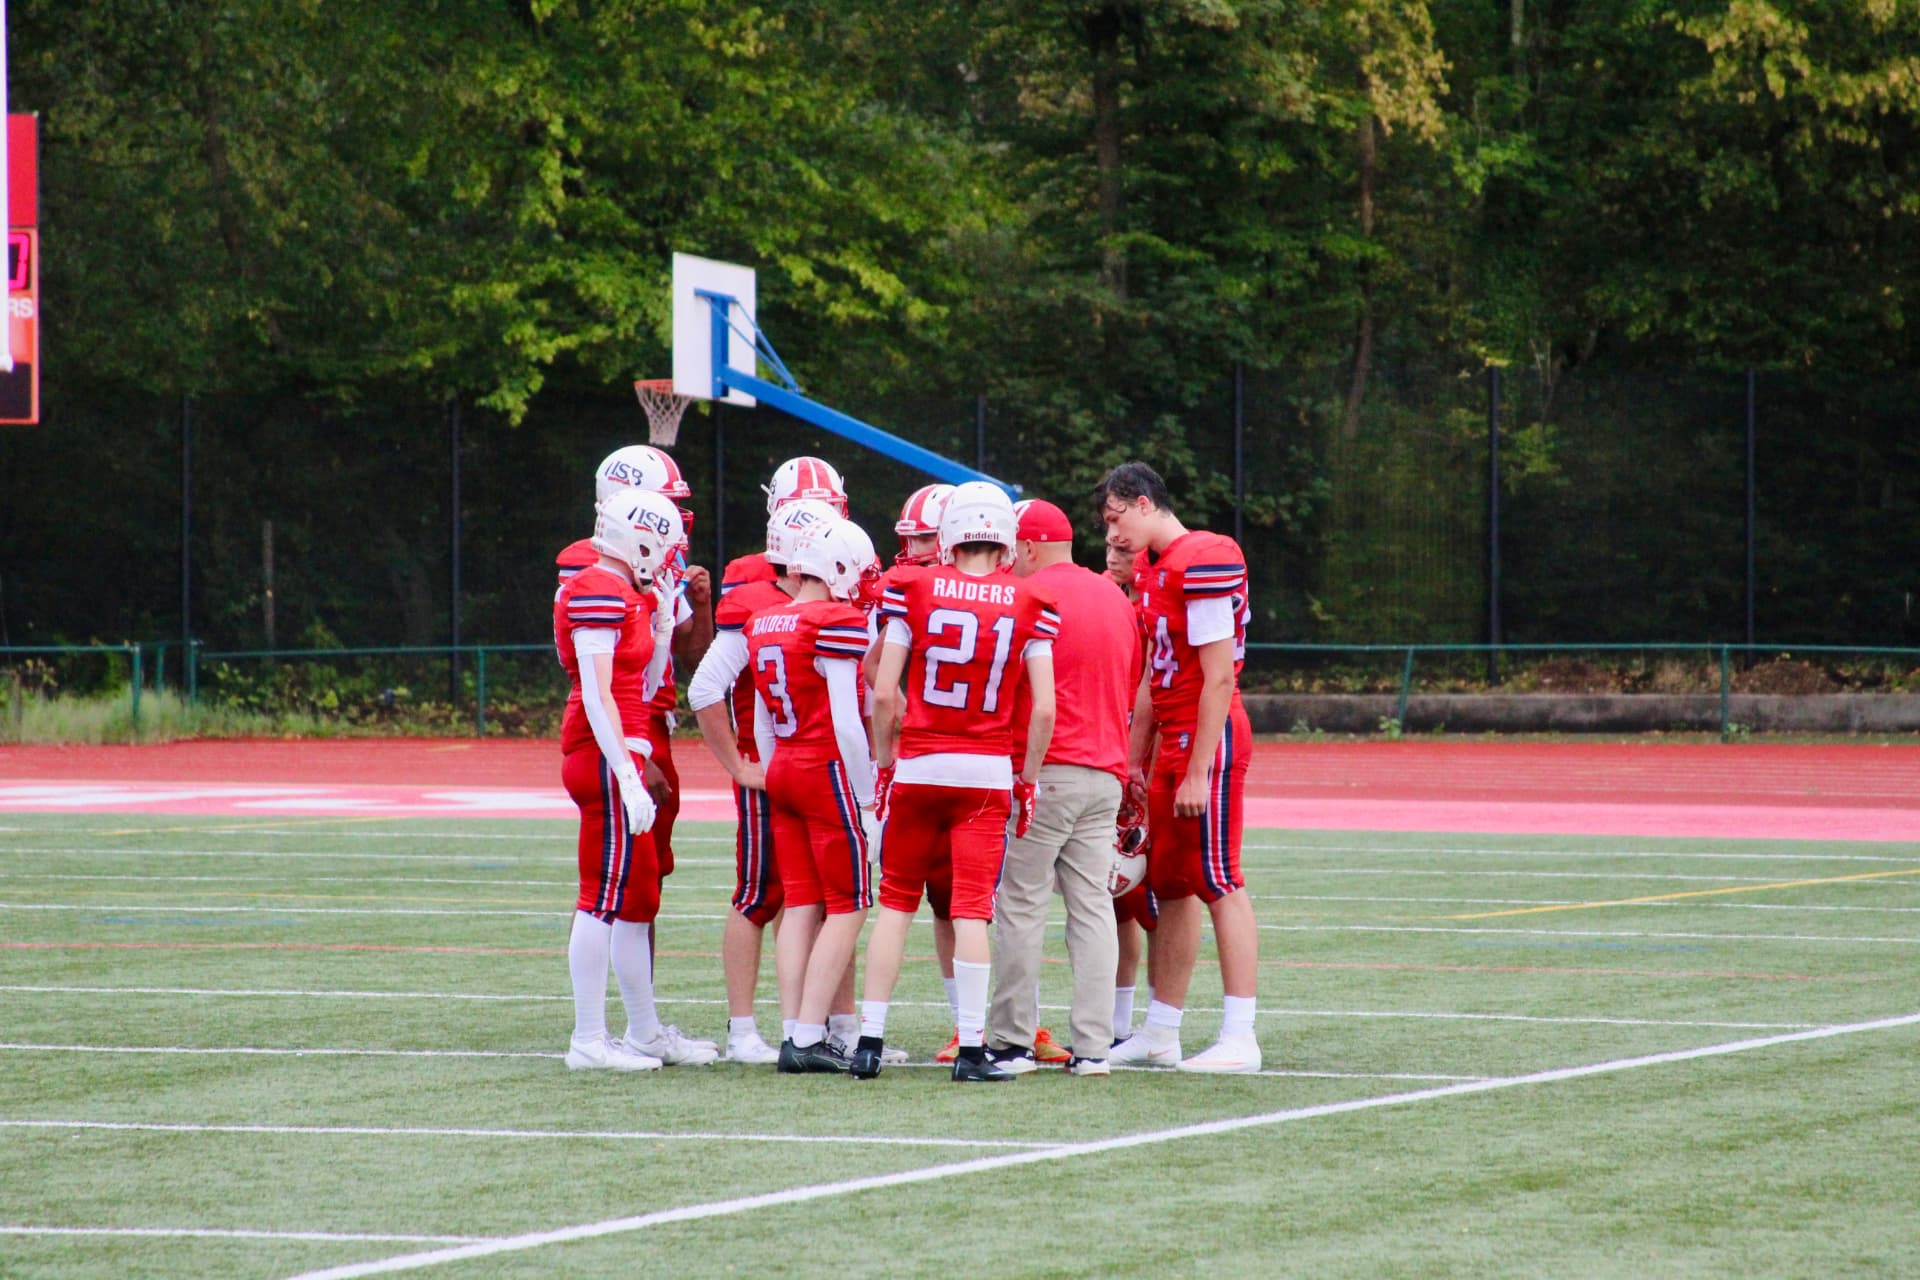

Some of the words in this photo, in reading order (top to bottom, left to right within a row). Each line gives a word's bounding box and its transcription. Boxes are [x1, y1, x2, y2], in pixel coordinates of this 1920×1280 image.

[637, 508, 671, 536] ISB
[963, 531, 1000, 541] Riddell
[933, 577, 1016, 606] RAIDERS
[752, 614, 800, 637] RAIDERS
[922, 607, 1016, 713] 21
[756, 643, 799, 738] 3
